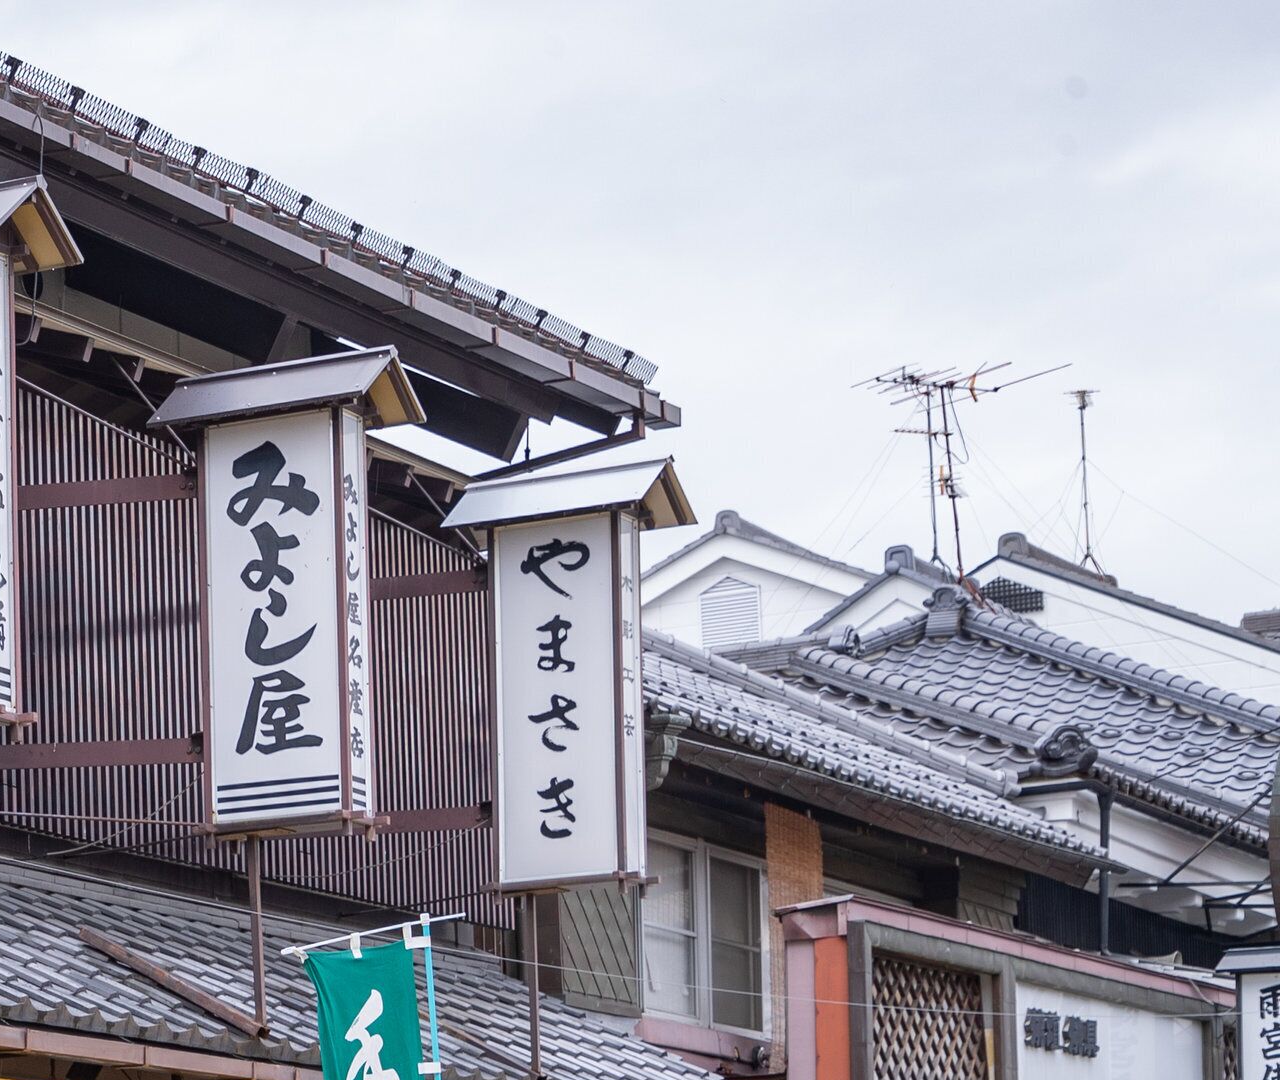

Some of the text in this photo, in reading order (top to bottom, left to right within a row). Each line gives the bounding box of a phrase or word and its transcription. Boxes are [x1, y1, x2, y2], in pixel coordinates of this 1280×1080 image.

[226, 440, 323, 755] みよし屋
[520, 538, 590, 839] やまさき
